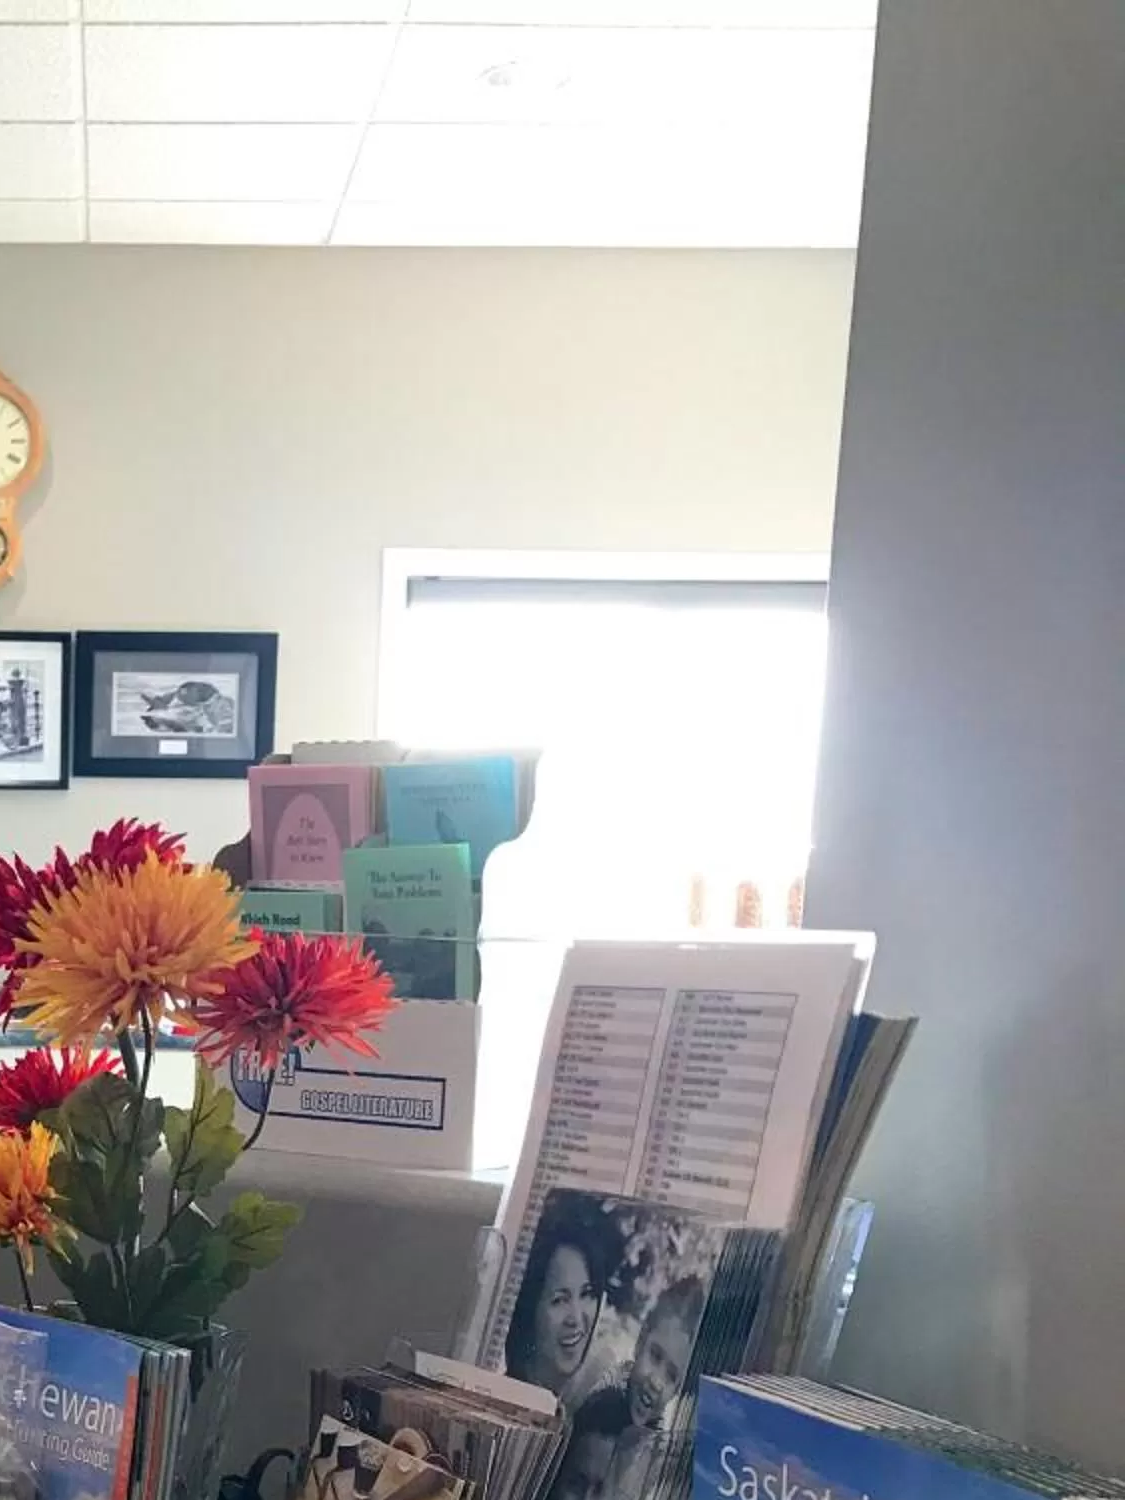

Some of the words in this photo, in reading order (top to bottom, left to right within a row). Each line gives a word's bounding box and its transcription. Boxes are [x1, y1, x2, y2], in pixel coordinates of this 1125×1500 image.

[272, 913, 301, 927] Road
[300, 1089, 350, 1115] GOSPEL
[351, 1092, 434, 1121] LITERATURE
